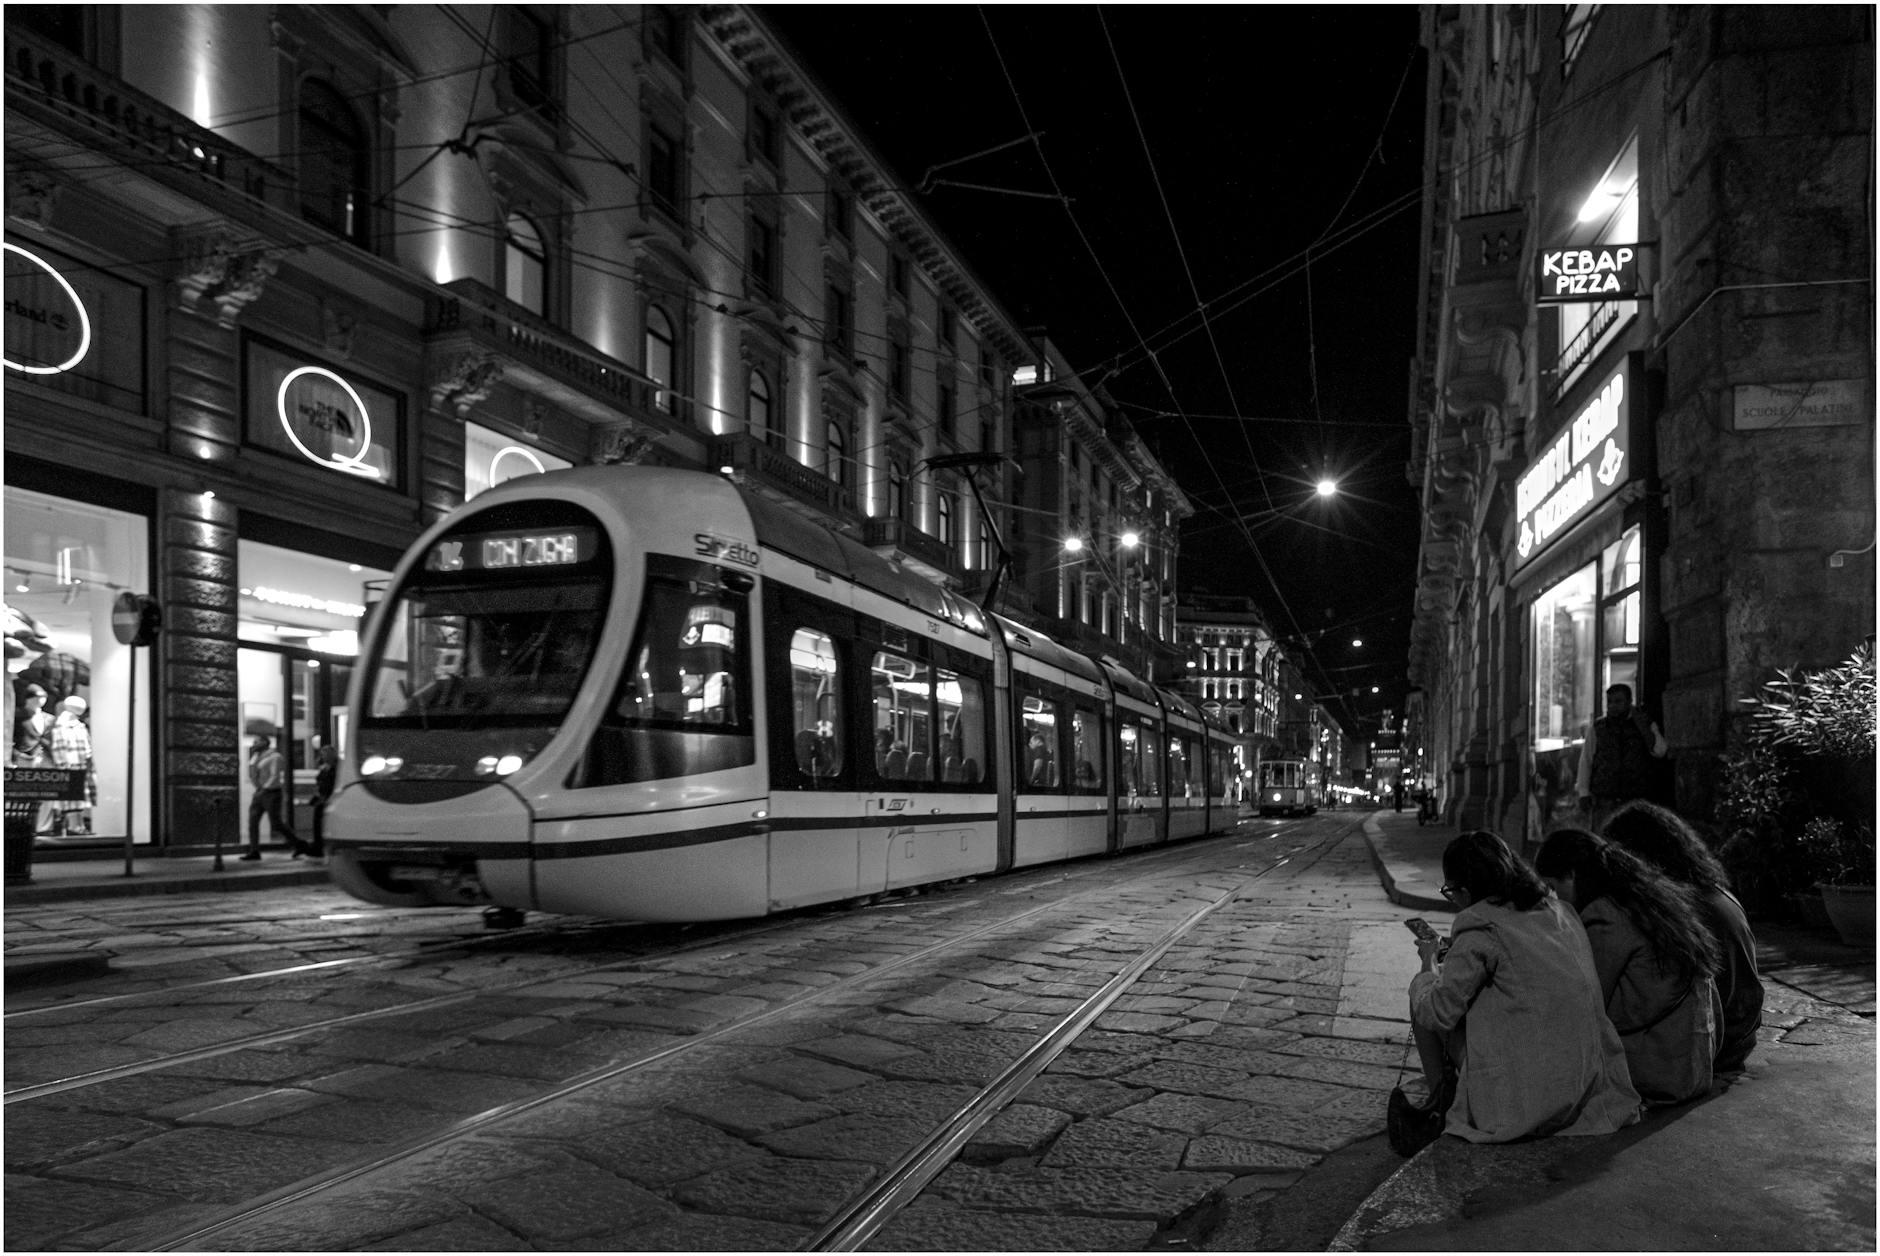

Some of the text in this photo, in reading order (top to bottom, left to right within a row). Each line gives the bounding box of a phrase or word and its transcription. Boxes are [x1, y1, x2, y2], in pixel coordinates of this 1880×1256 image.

[1543, 248, 1634, 277] KEBAP
[1556, 272, 1621, 295] PIZZA
[1742, 402, 1855, 418] SCUOLE PALATINE
[694, 533, 760, 565] Siretto
[15, 770, 70, 782] SEASON
